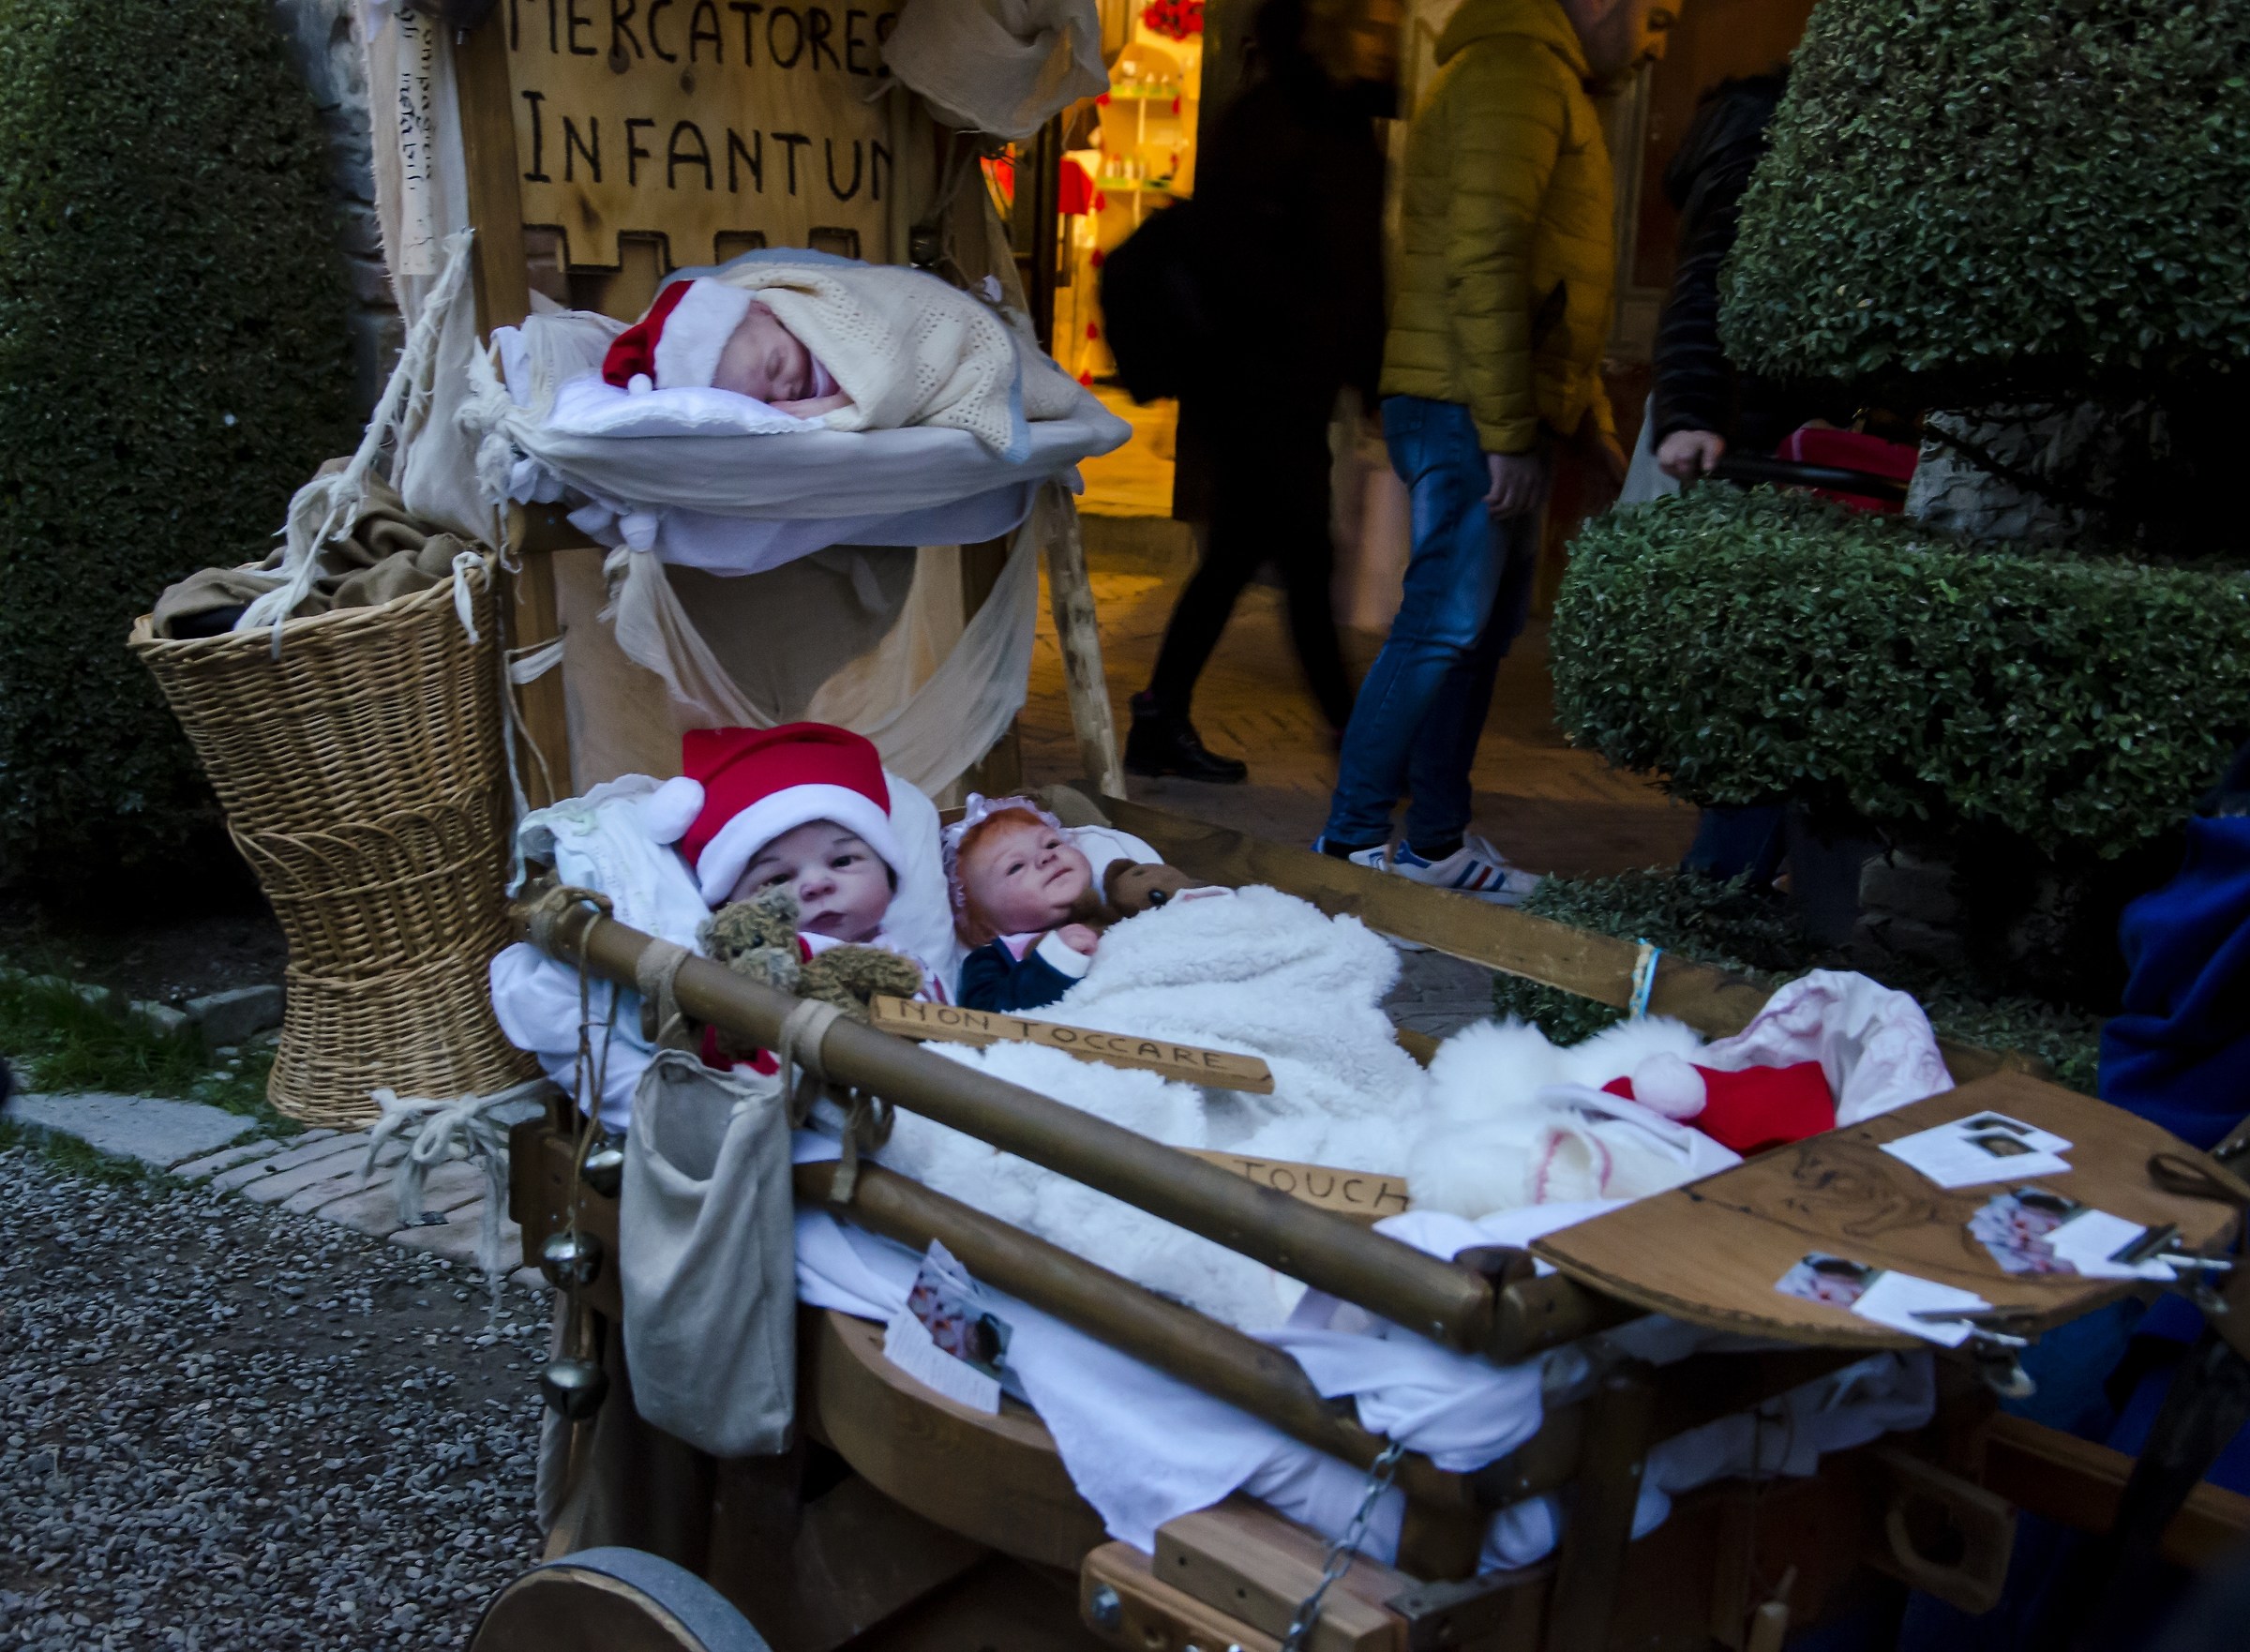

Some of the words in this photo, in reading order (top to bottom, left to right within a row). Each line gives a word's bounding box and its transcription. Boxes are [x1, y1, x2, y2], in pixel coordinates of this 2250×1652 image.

[900, 999, 989, 1030] NON
[1011, 1019, 1228, 1070] TOCCARE
[1234, 1159, 1411, 1212] TOUCH
